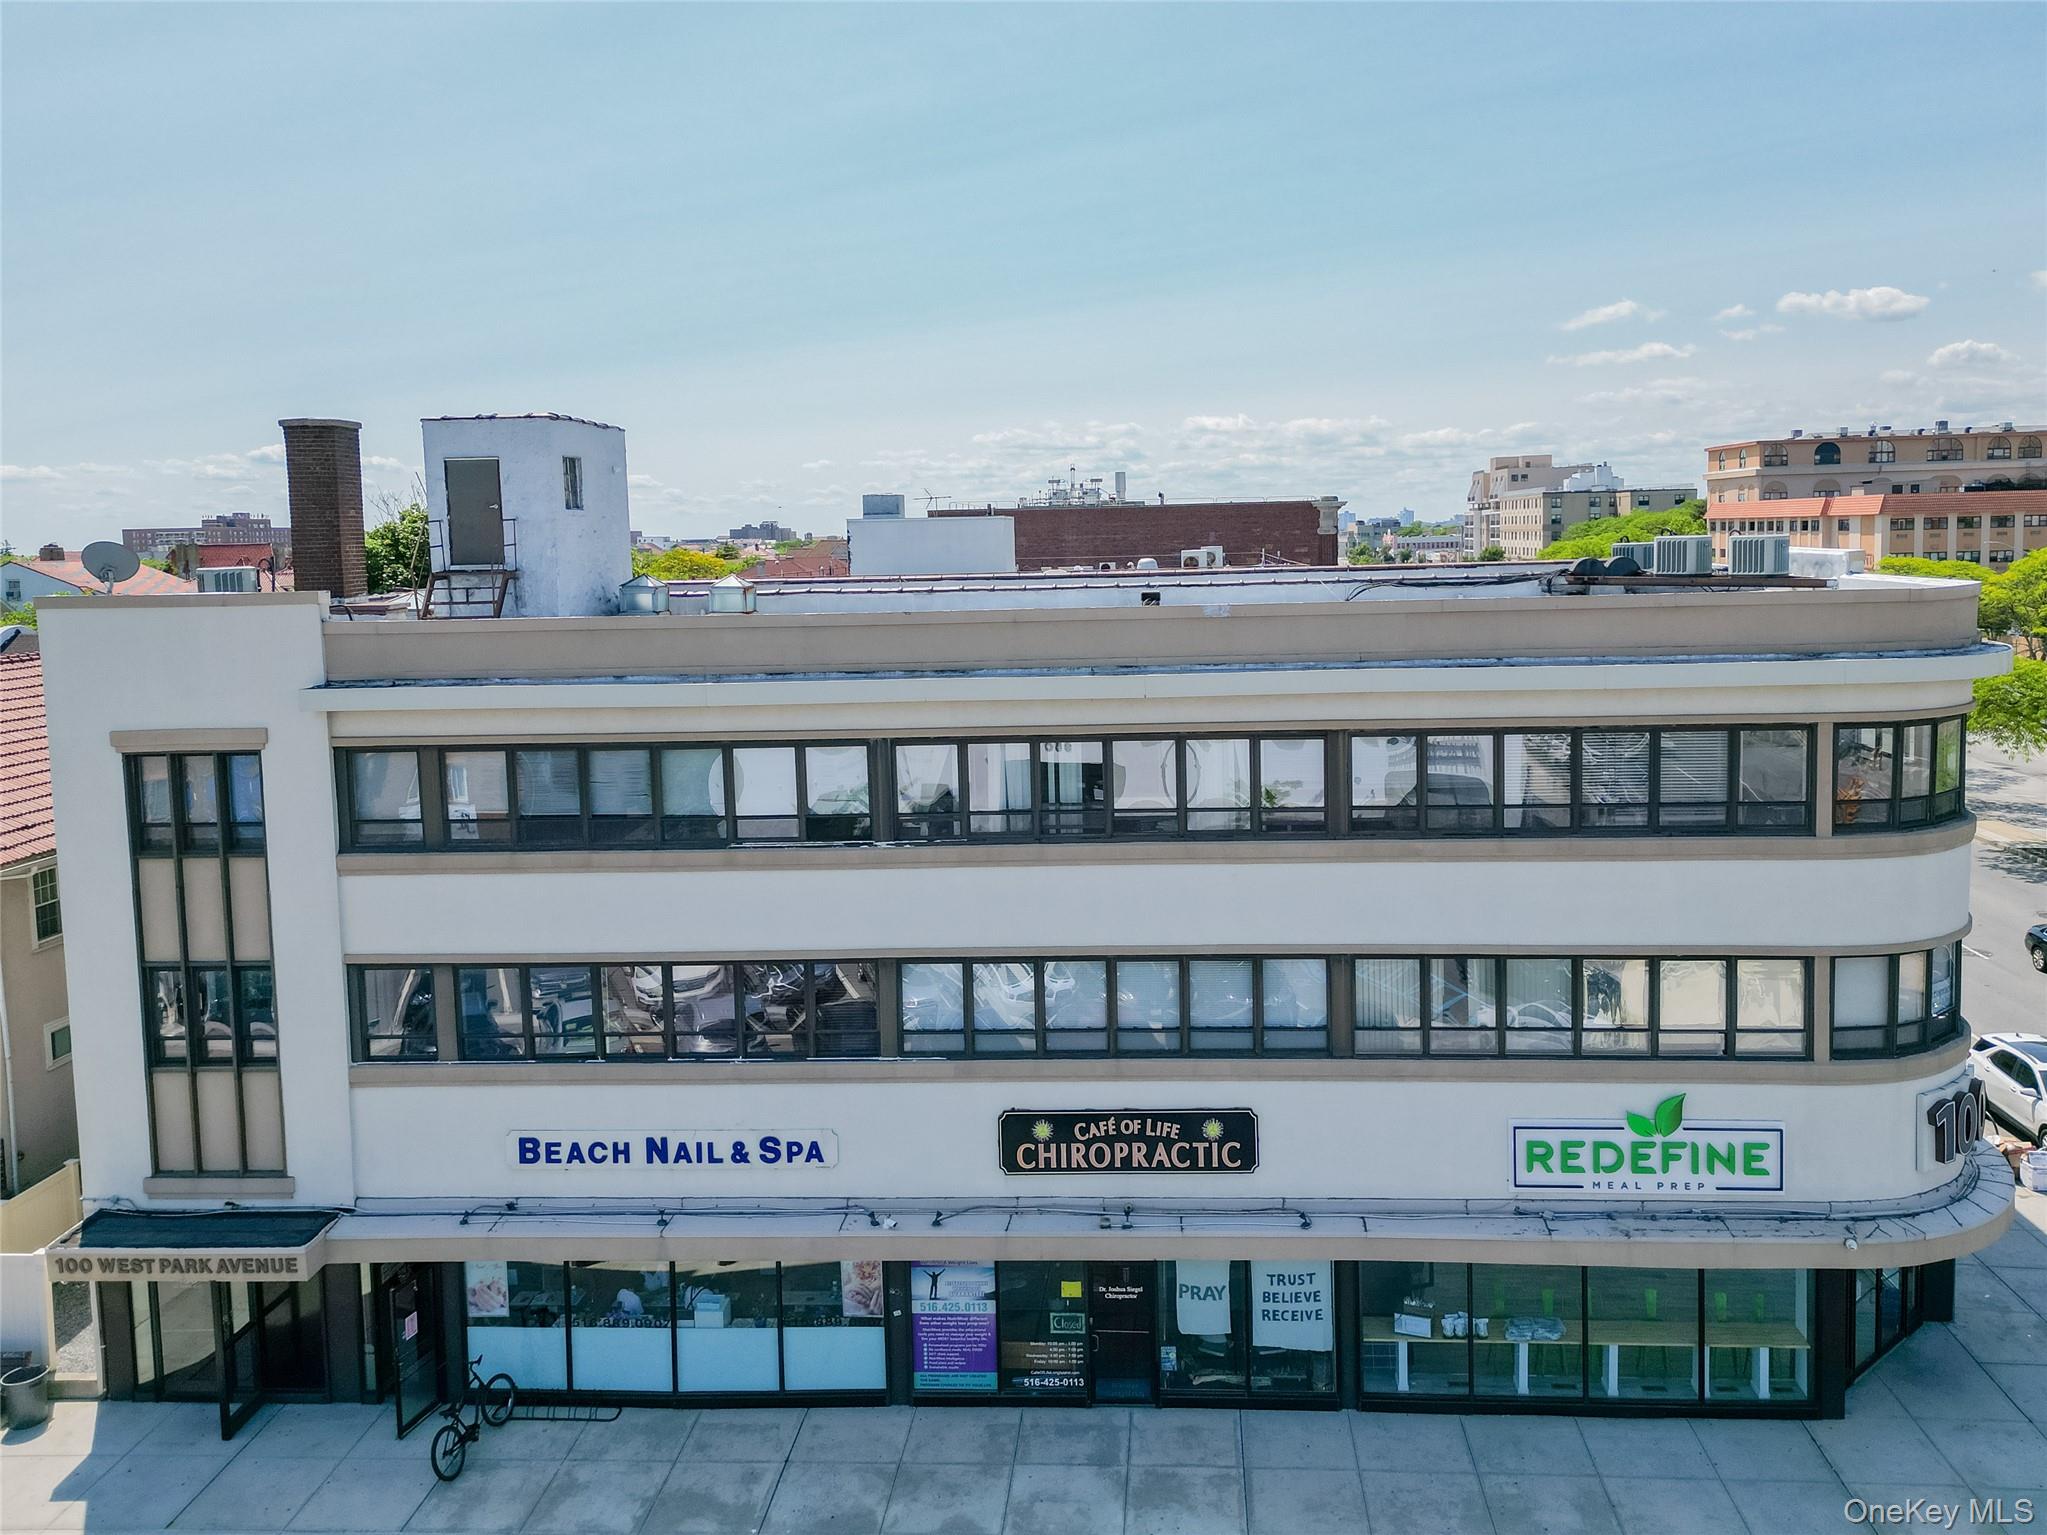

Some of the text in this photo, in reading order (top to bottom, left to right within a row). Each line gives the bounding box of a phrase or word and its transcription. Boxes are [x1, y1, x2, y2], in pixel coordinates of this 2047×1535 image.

[1074, 1116, 1181, 1141] CAFÉ OF LIFE
[1927, 1077, 1986, 1165] 100
[731, 1141, 750, 1164] &
[1016, 1142, 1241, 1169] CHIROPRACTIC
[1525, 1140, 1770, 1176] REDEFINE
[1592, 1181, 1706, 1191] MEAL PREP
[55, 1257, 298, 1274] 100 WEST PARK AVENUE
[1266, 1272, 1316, 1286] TRUST
[1178, 1283, 1226, 1301] PRAY
[1262, 1290, 1321, 1304] BELIEVE
[920, 1302, 987, 1312] 516.425.0113
[1053, 1317, 1082, 1329] Closed
[1262, 1309, 1323, 1322] RECEIVE
[1023, 1378, 1085, 1387] 516-425-0113
